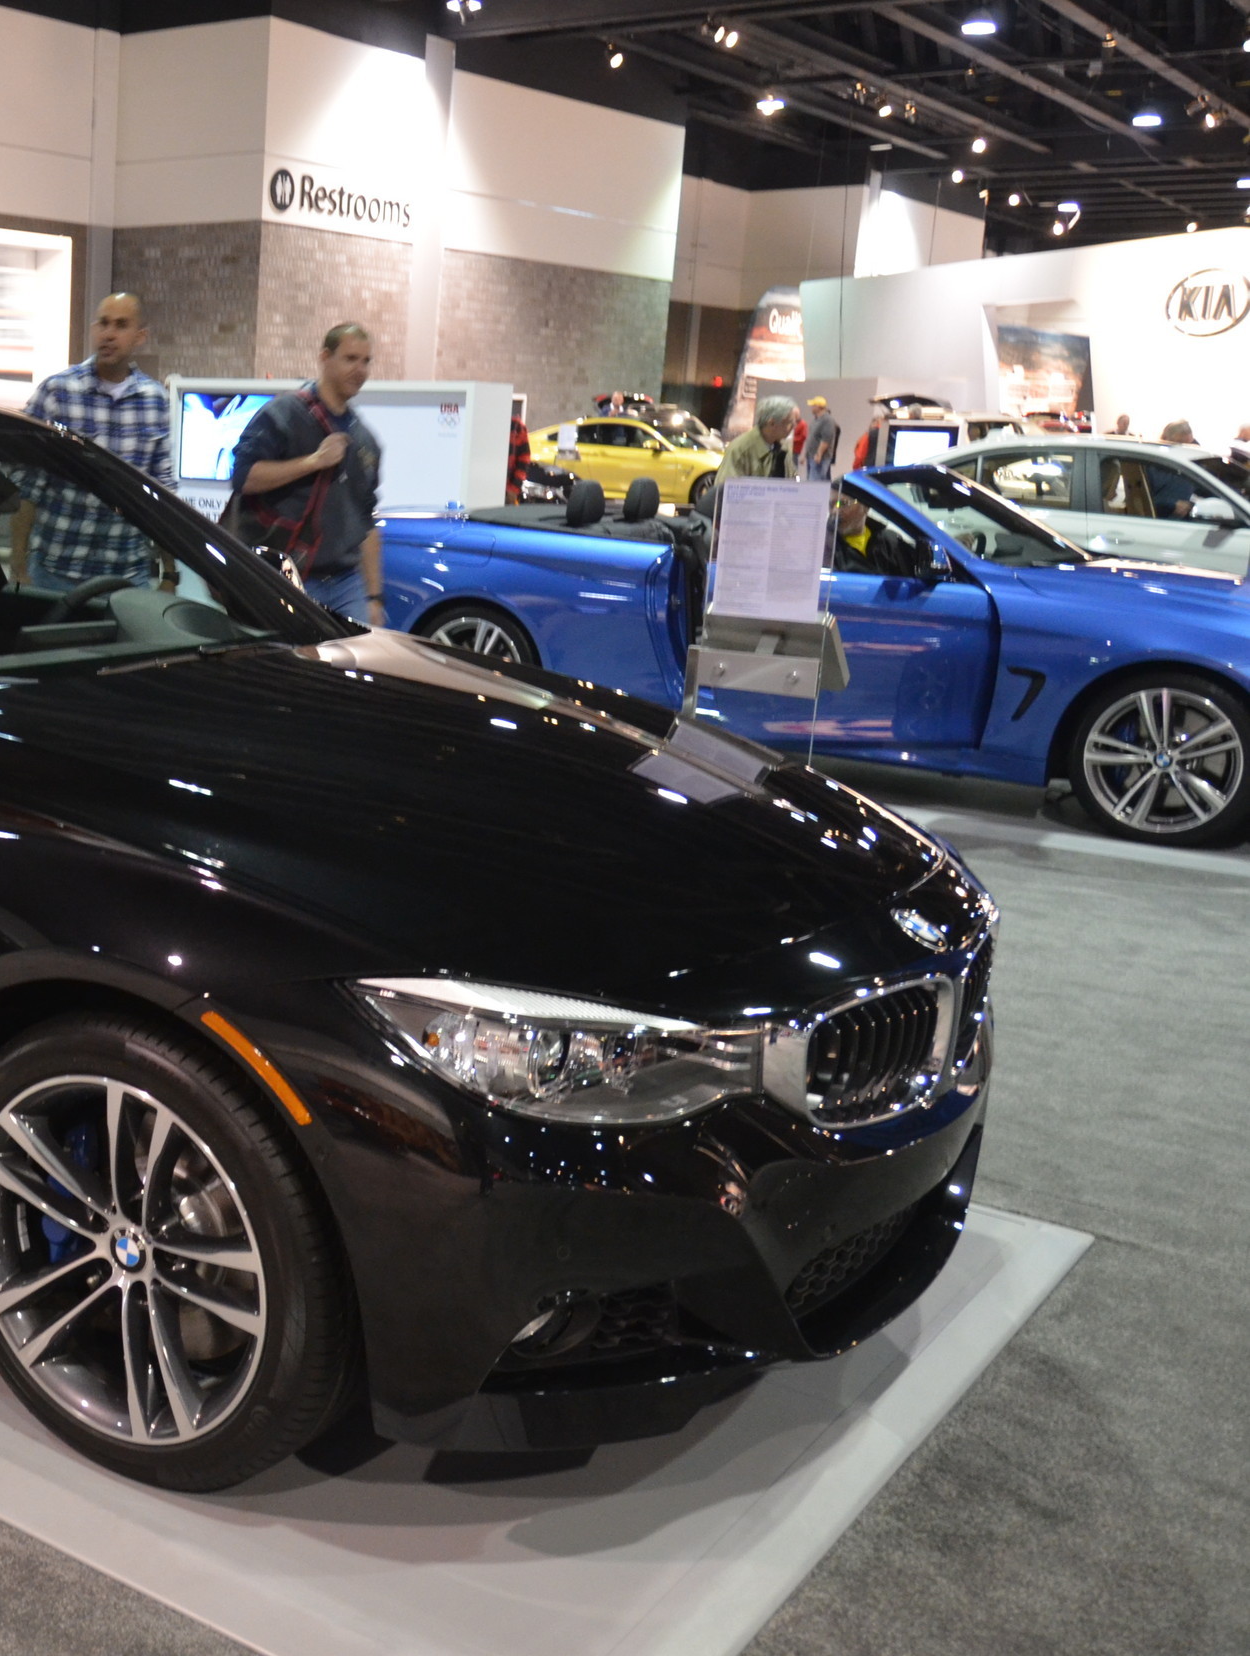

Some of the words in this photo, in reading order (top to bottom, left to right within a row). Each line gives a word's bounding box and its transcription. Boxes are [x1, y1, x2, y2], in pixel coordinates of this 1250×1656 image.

[299, 174, 410, 228] Restrooms
[1178, 283, 1236, 322] KIA
[198, 497, 222, 509] ONLY
